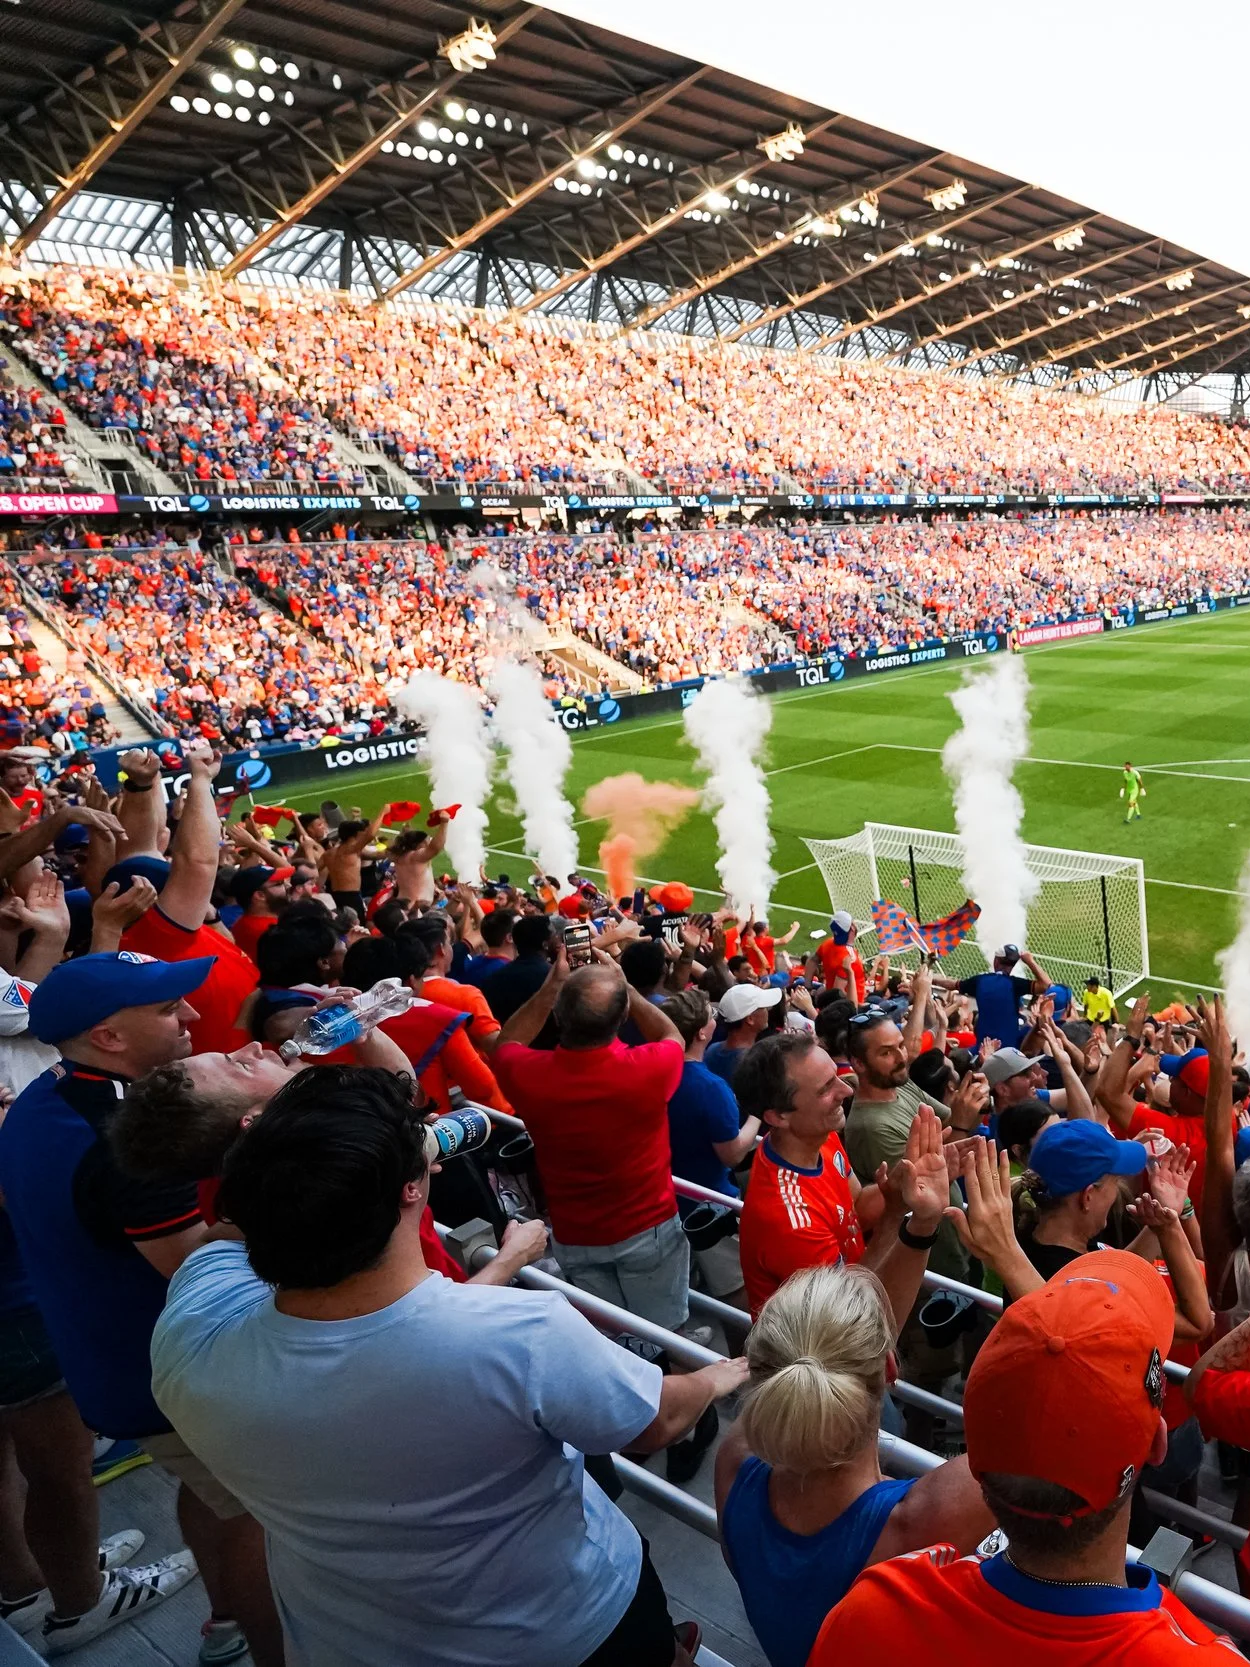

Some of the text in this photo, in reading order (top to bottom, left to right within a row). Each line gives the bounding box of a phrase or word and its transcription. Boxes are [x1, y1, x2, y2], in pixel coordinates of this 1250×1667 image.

[19, 496, 68, 511] OPEN
[68, 496, 104, 511] CUP
[144, 496, 190, 512] TQL
[222, 497, 361, 509] LOGISTICS EXPERTS
[371, 496, 405, 510] TQL
[481, 498, 510, 506] OCEAN
[542, 496, 569, 509] TQL
[587, 496, 673, 506] LOGISTICS EXPERTS
[678, 496, 700, 507] TQL
[788, 495, 807, 506] TQL
[1073, 622, 1089, 635] OPEN
[1089, 620, 1101, 632] CUP
[1111, 616, 1128, 629] TQL
[962, 639, 987, 656] TQL
[866, 647, 946, 671] LOGISTICS EXPERTS
[796, 667, 830, 687] TQL
